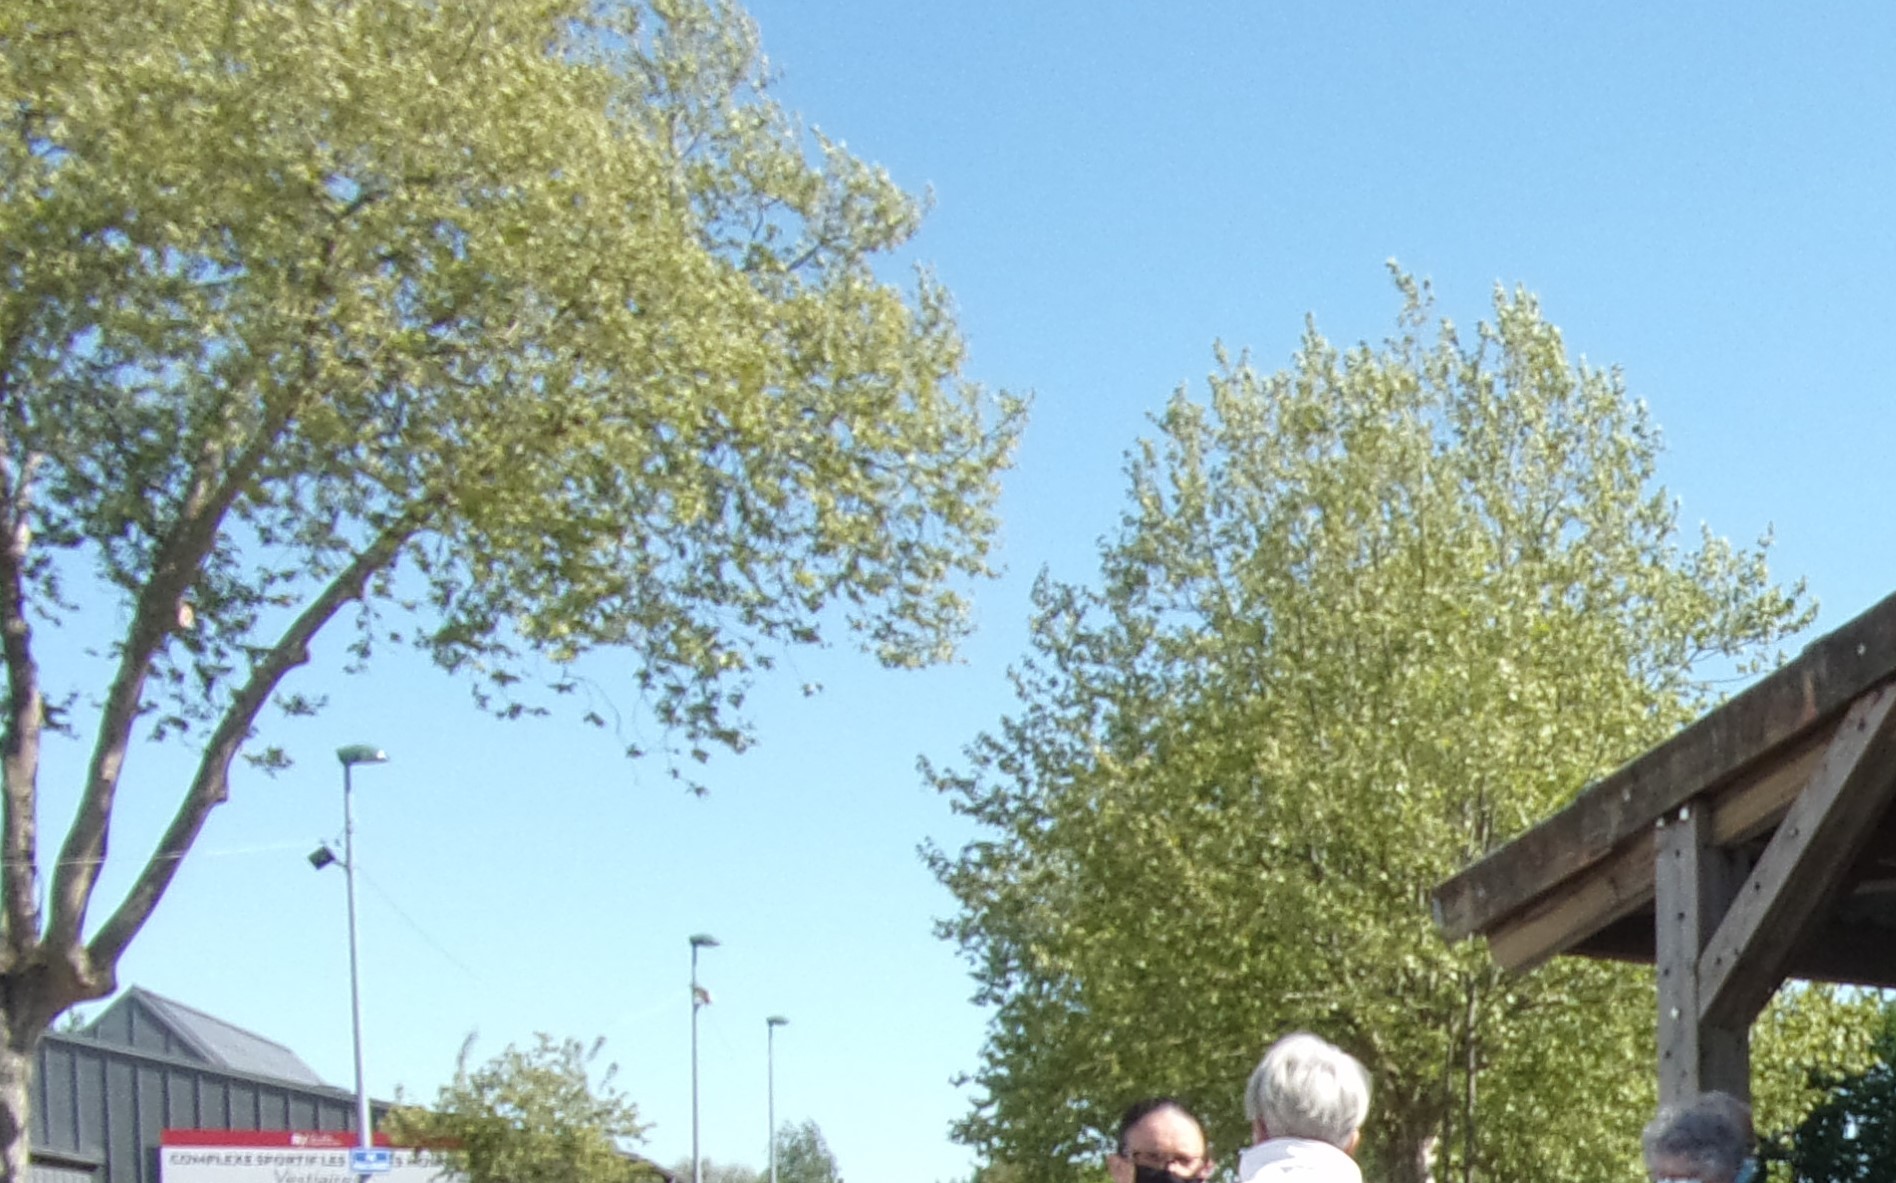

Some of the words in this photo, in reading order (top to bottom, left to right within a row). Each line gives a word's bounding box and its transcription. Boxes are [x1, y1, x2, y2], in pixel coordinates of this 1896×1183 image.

[169, 1152, 252, 1166] COMPLEXE
[257, 1153, 318, 1167] SPORTIF
[321, 1153, 346, 1167] LES
